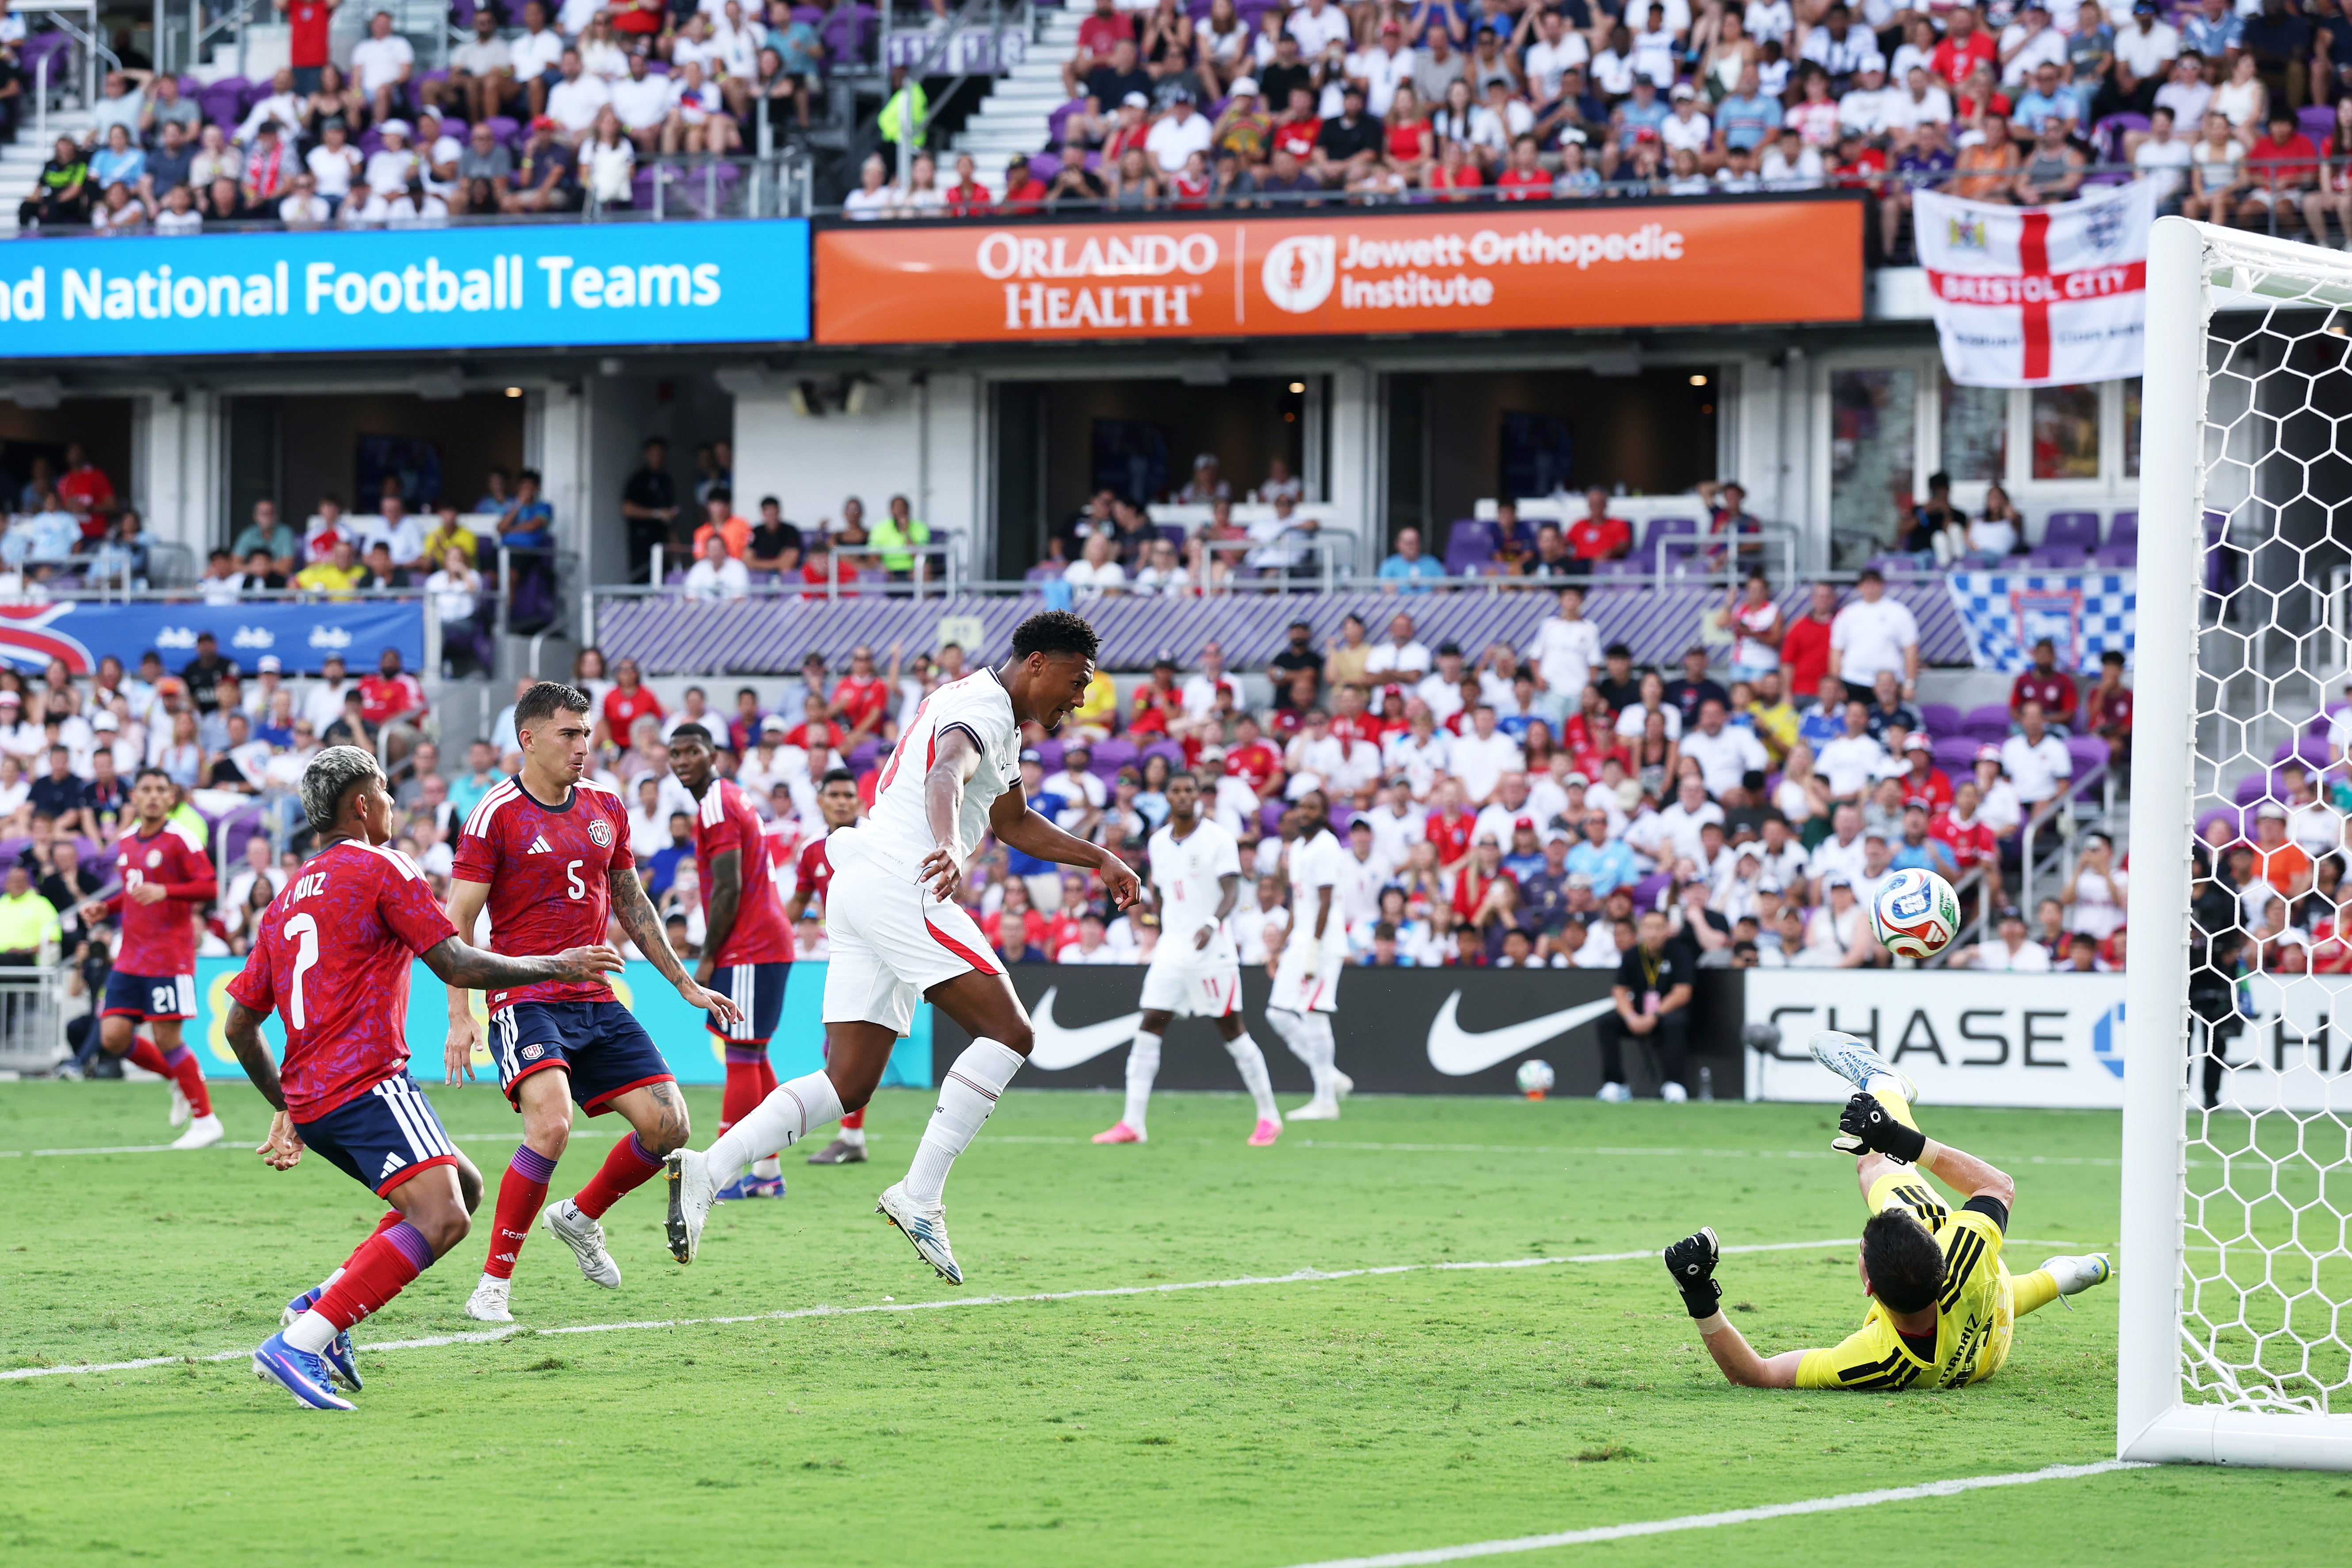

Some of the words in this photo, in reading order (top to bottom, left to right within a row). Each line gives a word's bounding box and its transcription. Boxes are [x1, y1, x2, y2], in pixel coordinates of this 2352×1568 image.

[1340, 234, 1465, 270] Jewett
[1469, 223, 1684, 270] Orthopedic
[63, 261, 289, 320] National
[306, 255, 523, 314] Football
[537, 256, 720, 308] Teams
[1341, 271, 1494, 309] Institute
[1942, 275, 2061, 303] BRISTOL
[2065, 268, 2129, 300] CITY
[293, 871, 327, 904] RUIZ
[567, 859, 586, 900] 5
[284, 912, 320, 1030] 7
[1202, 978, 1220, 998] 11
[152, 985, 177, 1013] 21
[526, 1045, 539, 1056] CR
[1769, 1006, 2068, 1067] CHASE
[1887, 1153, 1904, 1164] ELITE
[1712, 1281, 1721, 1295] ELITE
[1938, 1312, 1982, 1383] MADRIZ
